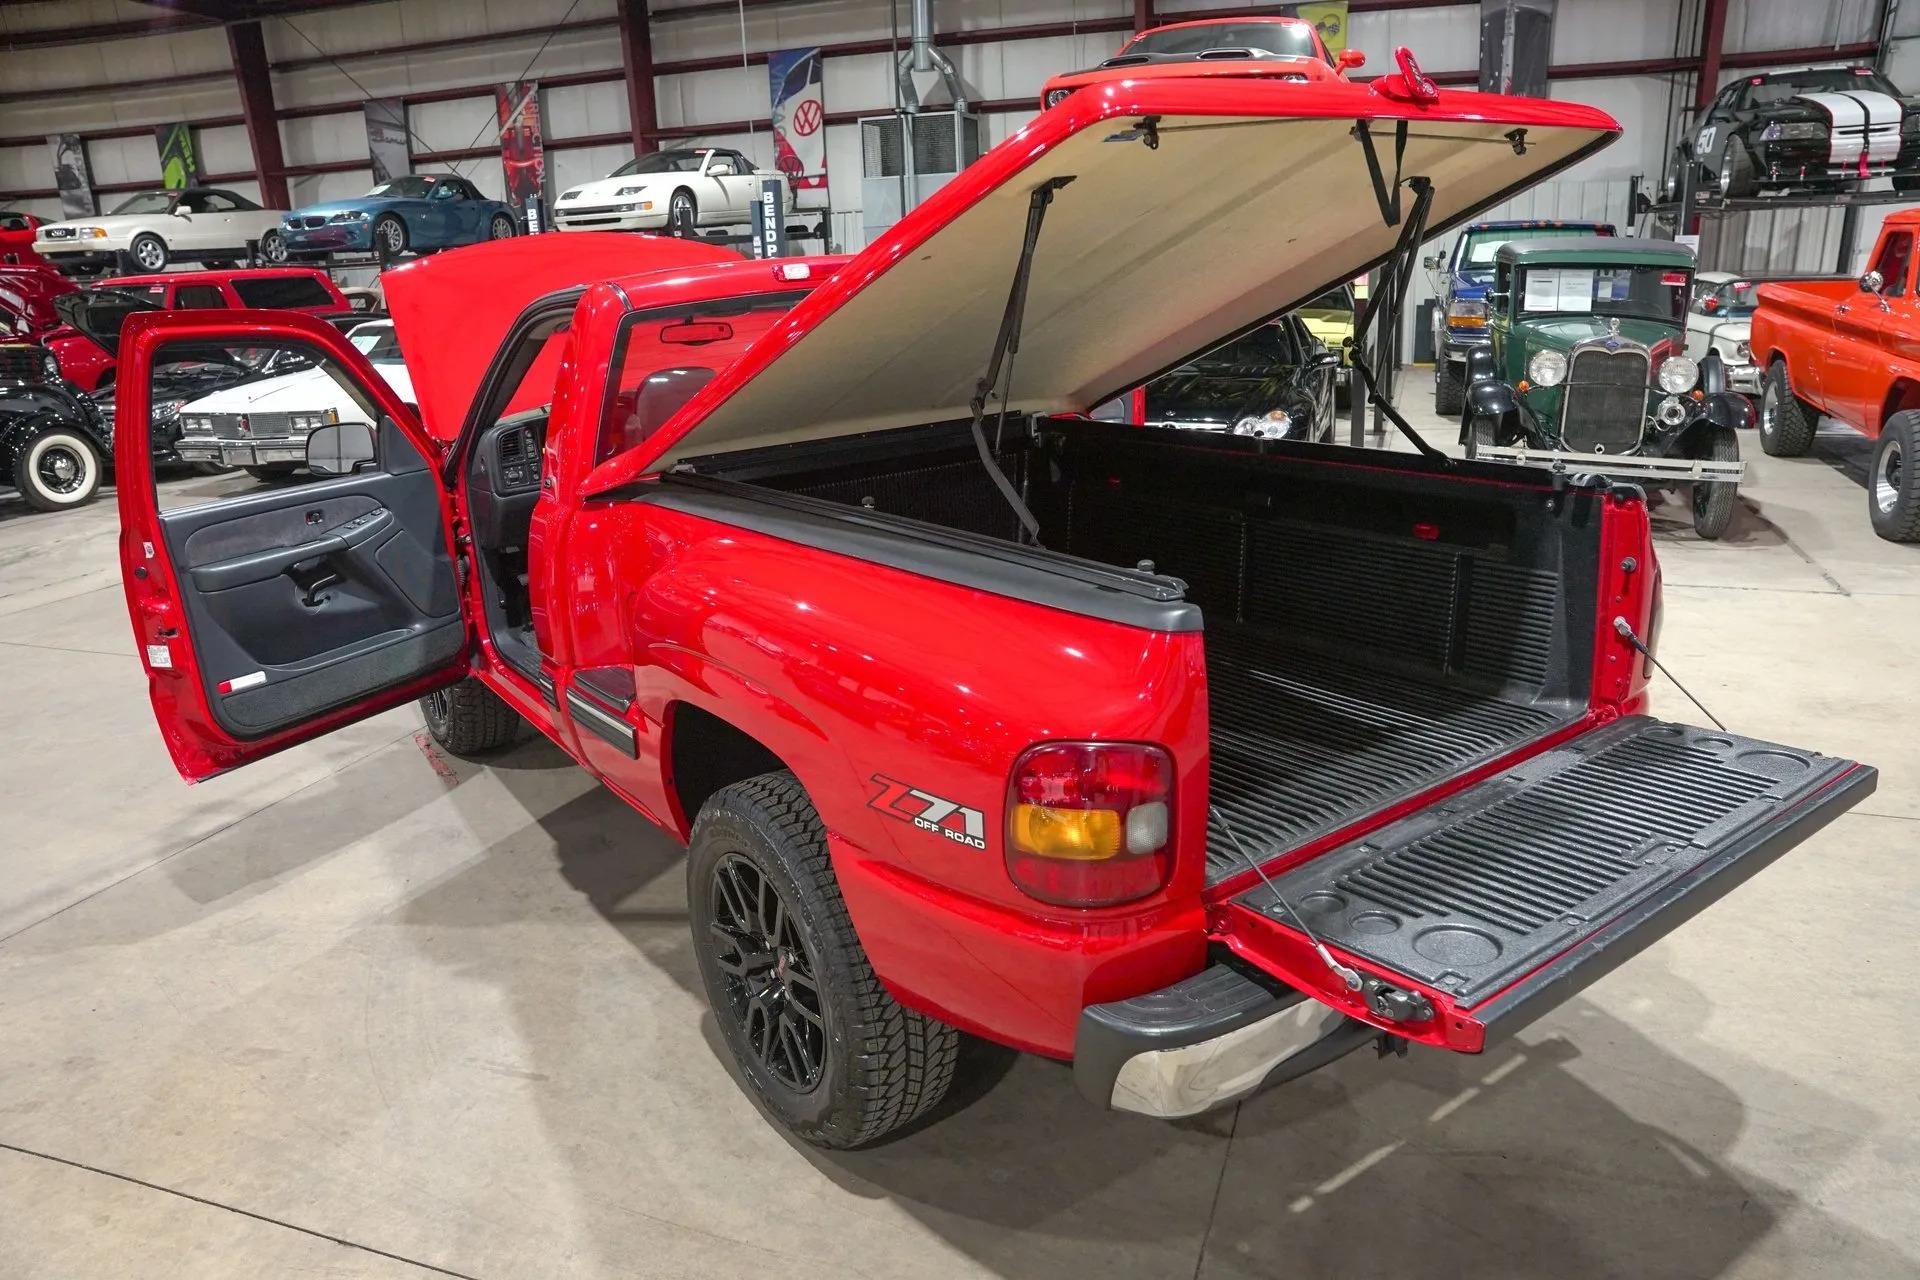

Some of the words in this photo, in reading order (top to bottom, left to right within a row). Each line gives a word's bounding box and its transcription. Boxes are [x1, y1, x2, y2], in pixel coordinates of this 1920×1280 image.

[1696, 126, 1717, 155] 50
[763, 191, 778, 259] BENDP
[914, 817, 939, 833] OFF
[944, 829, 986, 850] ROAD
